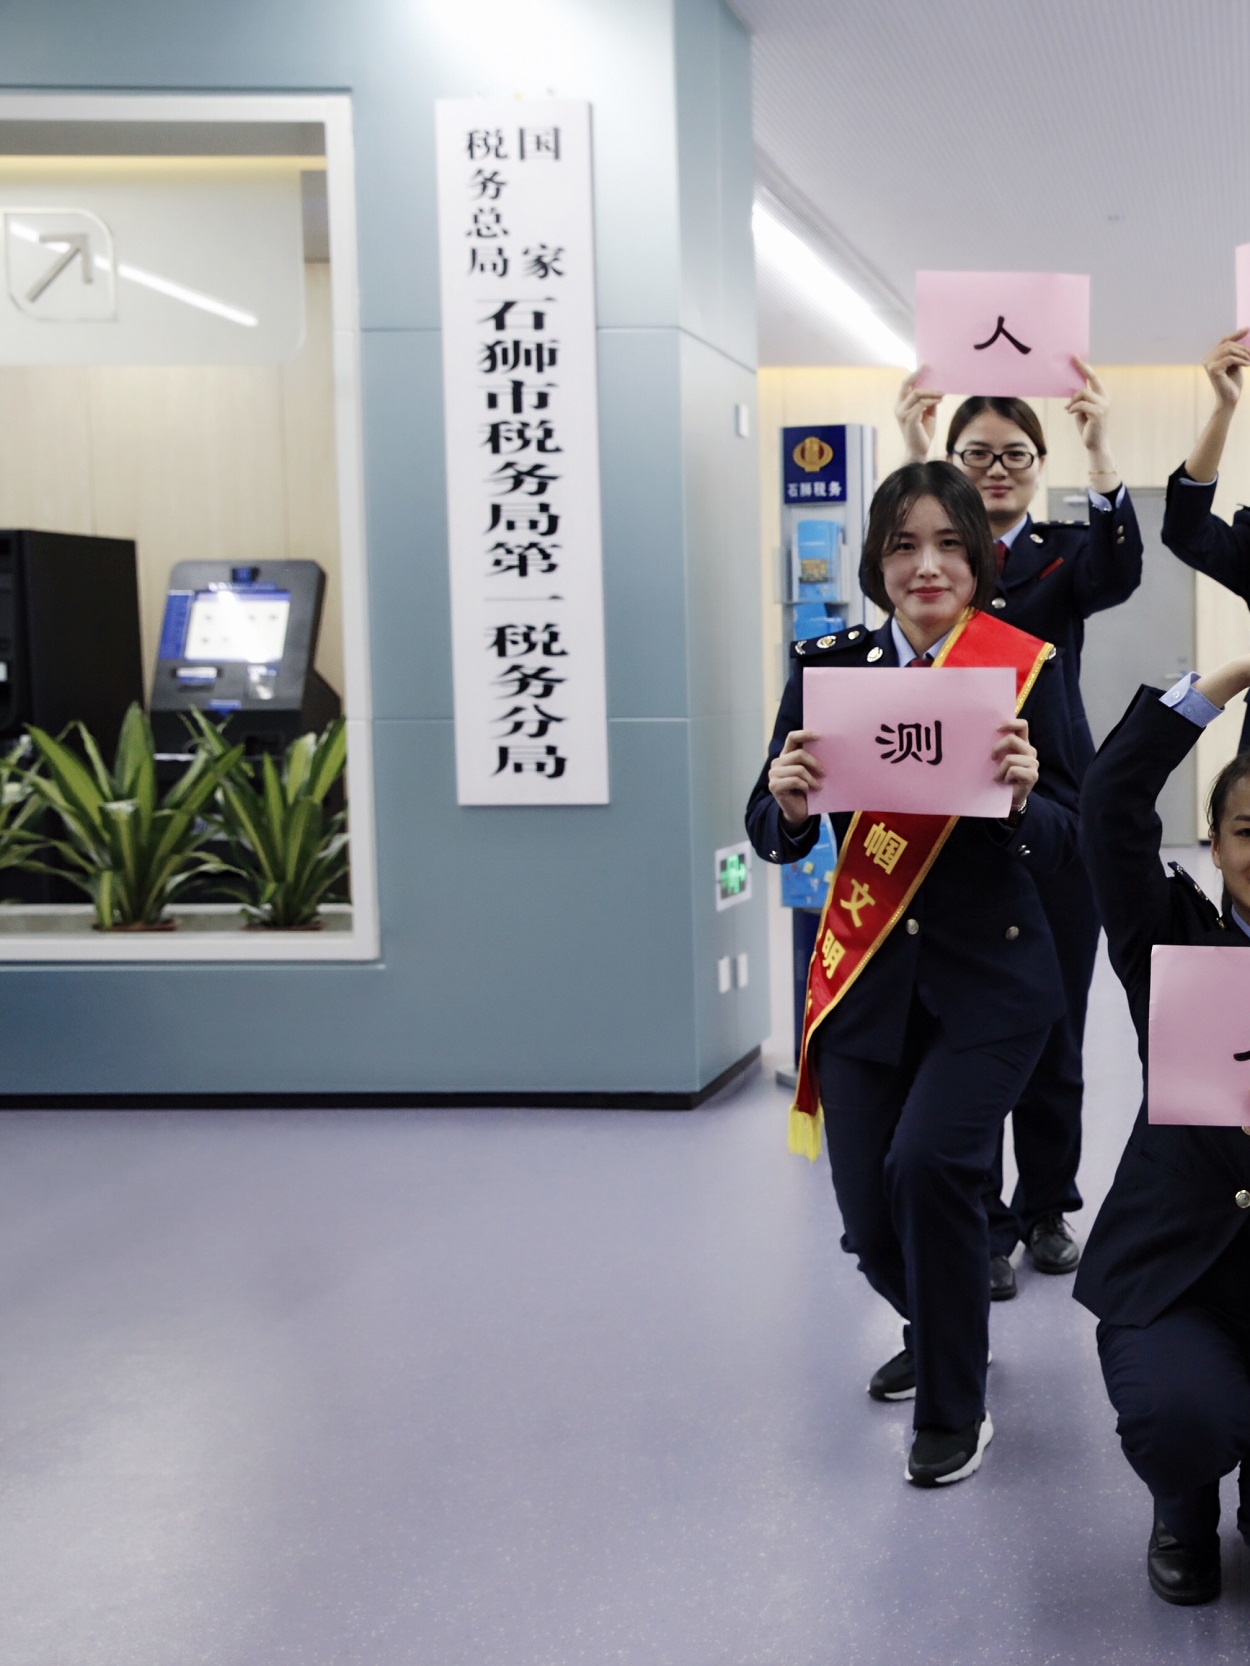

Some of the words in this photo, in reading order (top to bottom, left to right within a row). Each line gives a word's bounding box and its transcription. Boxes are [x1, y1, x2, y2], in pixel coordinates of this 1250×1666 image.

[465, 127, 509, 279] 税务总局
[518, 126, 565, 280] 国家
[974, 316, 1032, 355] 人
[475, 296, 570, 780] 石狮市税务局第一税务分局
[874, 719, 943, 766] 测
[806, 821, 909, 1016] 帼文明
